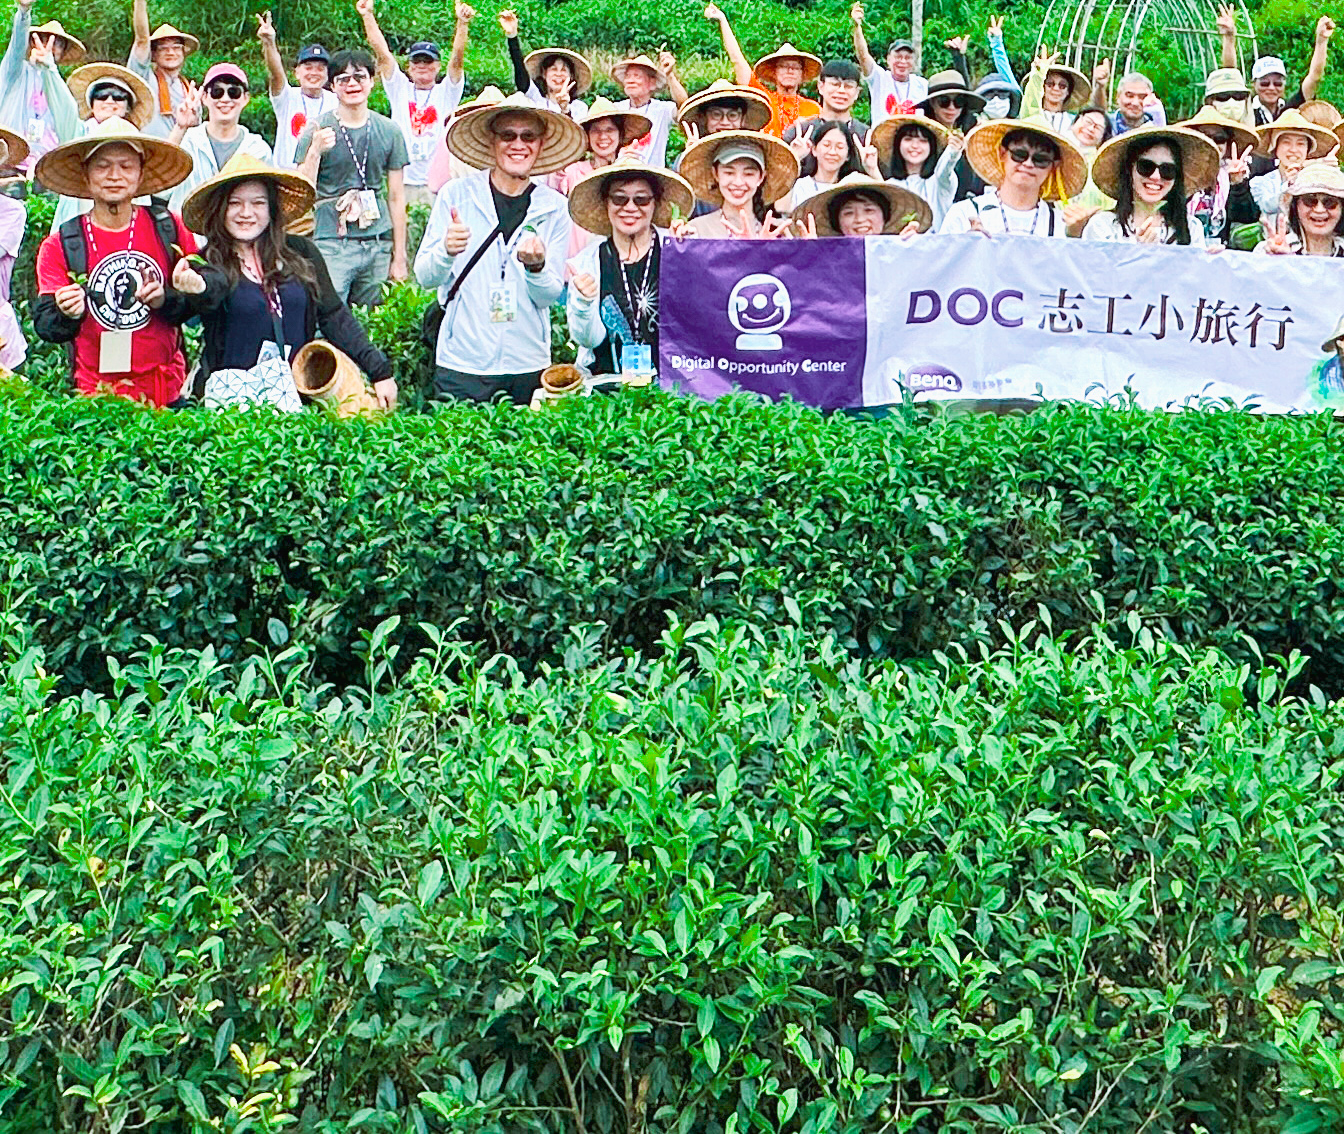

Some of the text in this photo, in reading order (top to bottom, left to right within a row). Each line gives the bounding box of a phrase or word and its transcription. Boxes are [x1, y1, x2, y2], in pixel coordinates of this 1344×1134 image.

[905, 286, 1295, 351] DOC 志工小旅行
[671, 355, 847, 376] Digital Opportunity Center
[909, 373, 957, 391] BenQ
